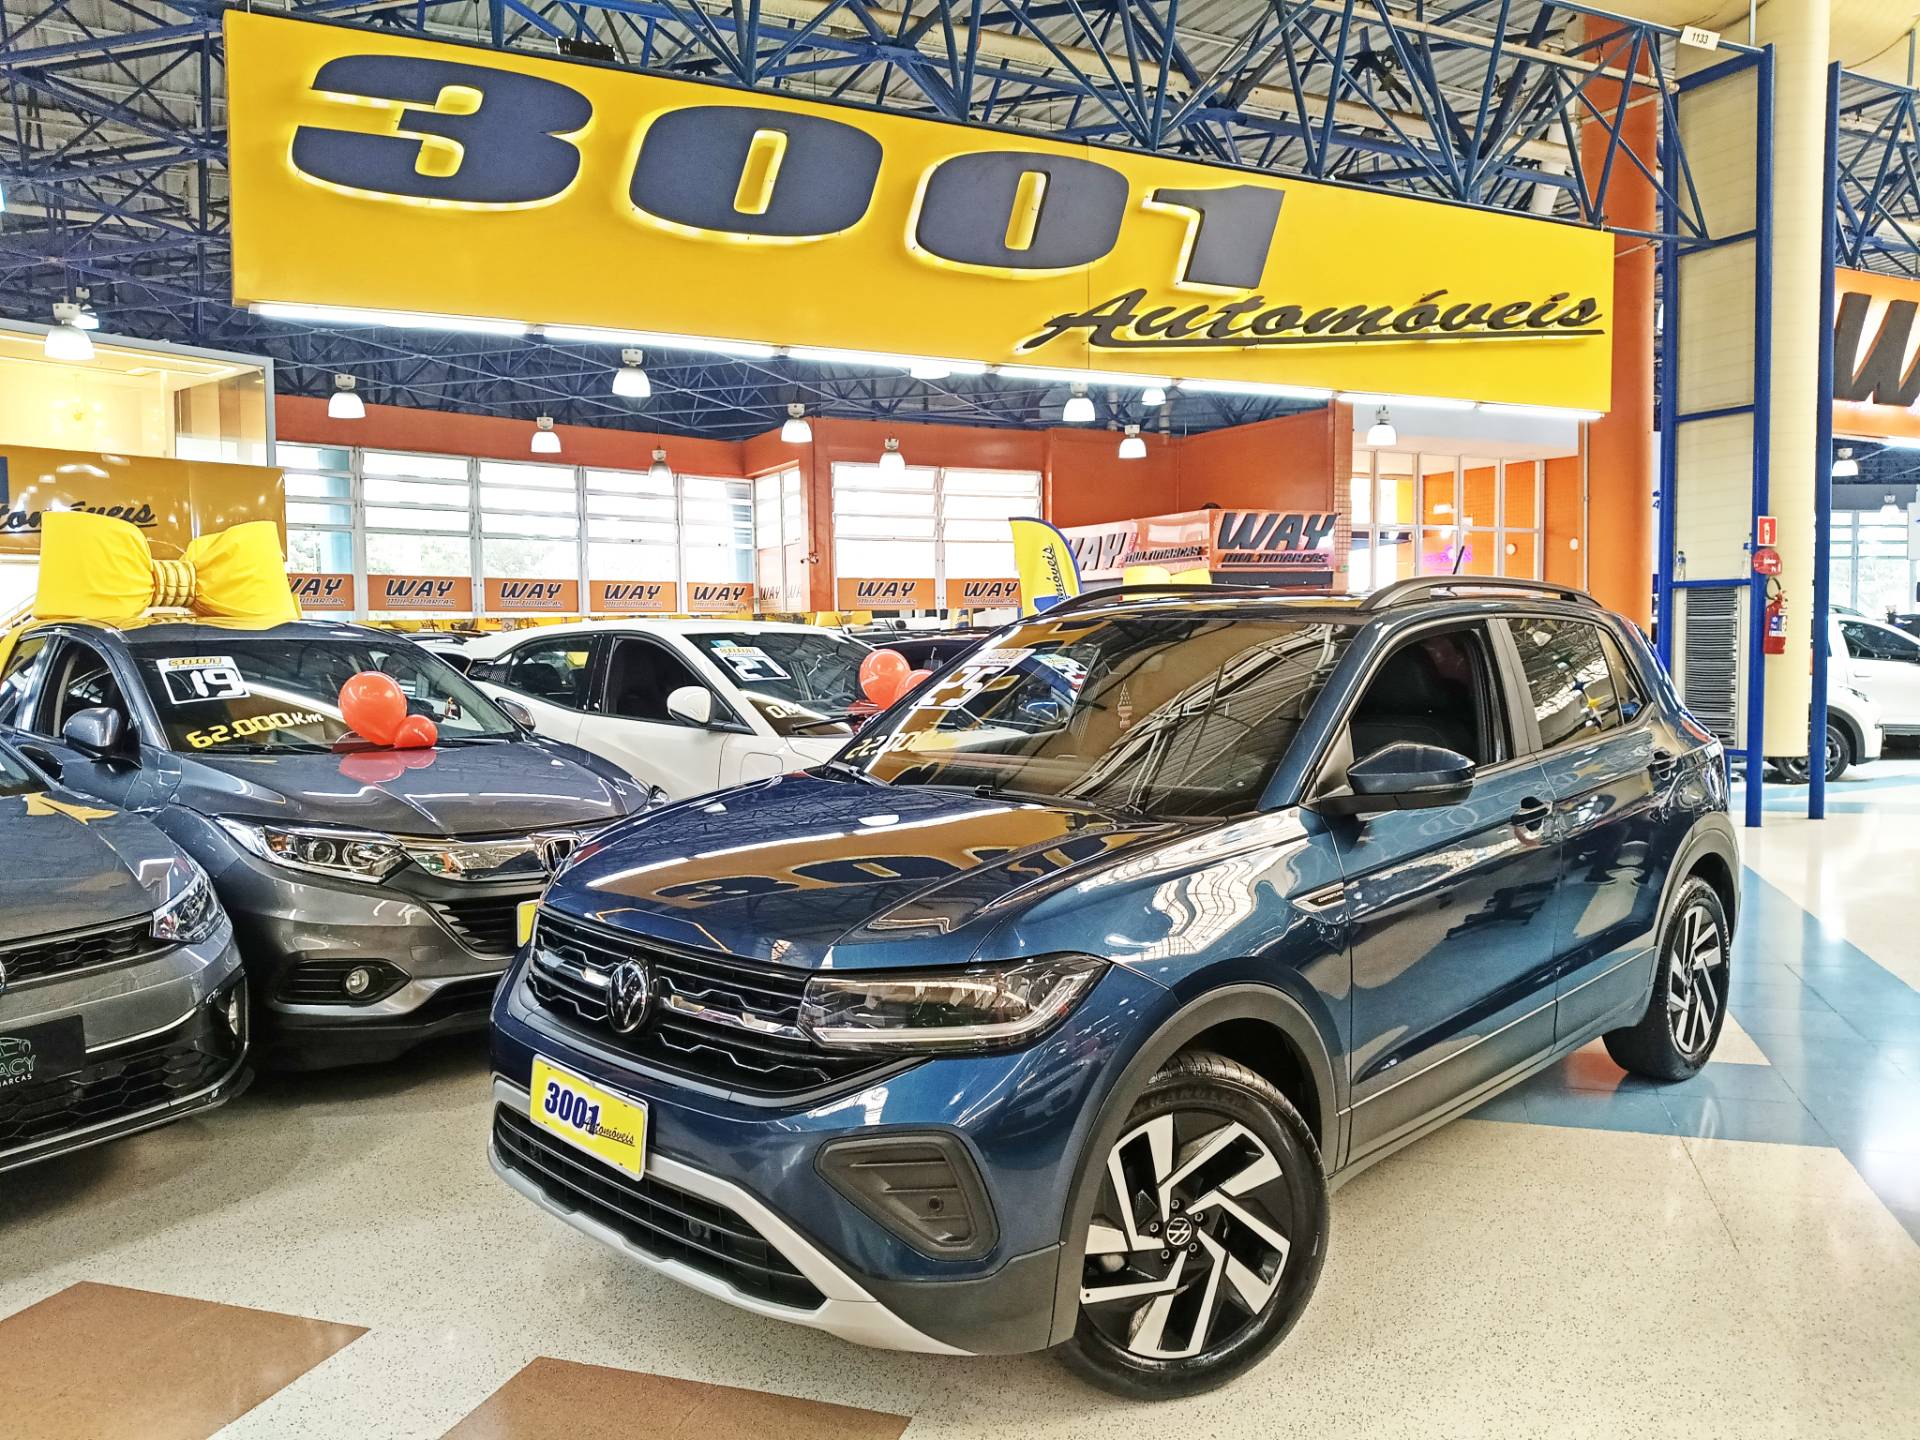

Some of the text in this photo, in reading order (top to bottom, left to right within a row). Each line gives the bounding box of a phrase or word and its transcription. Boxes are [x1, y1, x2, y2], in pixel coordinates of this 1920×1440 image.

[1691, 32, 1709, 45] 1133
[293, 54, 1285, 290] 3001
[1016, 287, 1604, 351] Automóveis
[1217, 512, 1338, 551] WAY
[386, 579, 454, 597] WAY
[500, 582, 562, 599] WAY
[603, 584, 662, 600] WAY
[693, 586, 746, 601] WAY
[857, 581, 916, 597] WAY
[964, 582, 1019, 597] WAY
[189, 668, 245, 698] 19
[186, 711, 324, 749] 62.000Km
[544, 1081, 600, 1136] 3001
